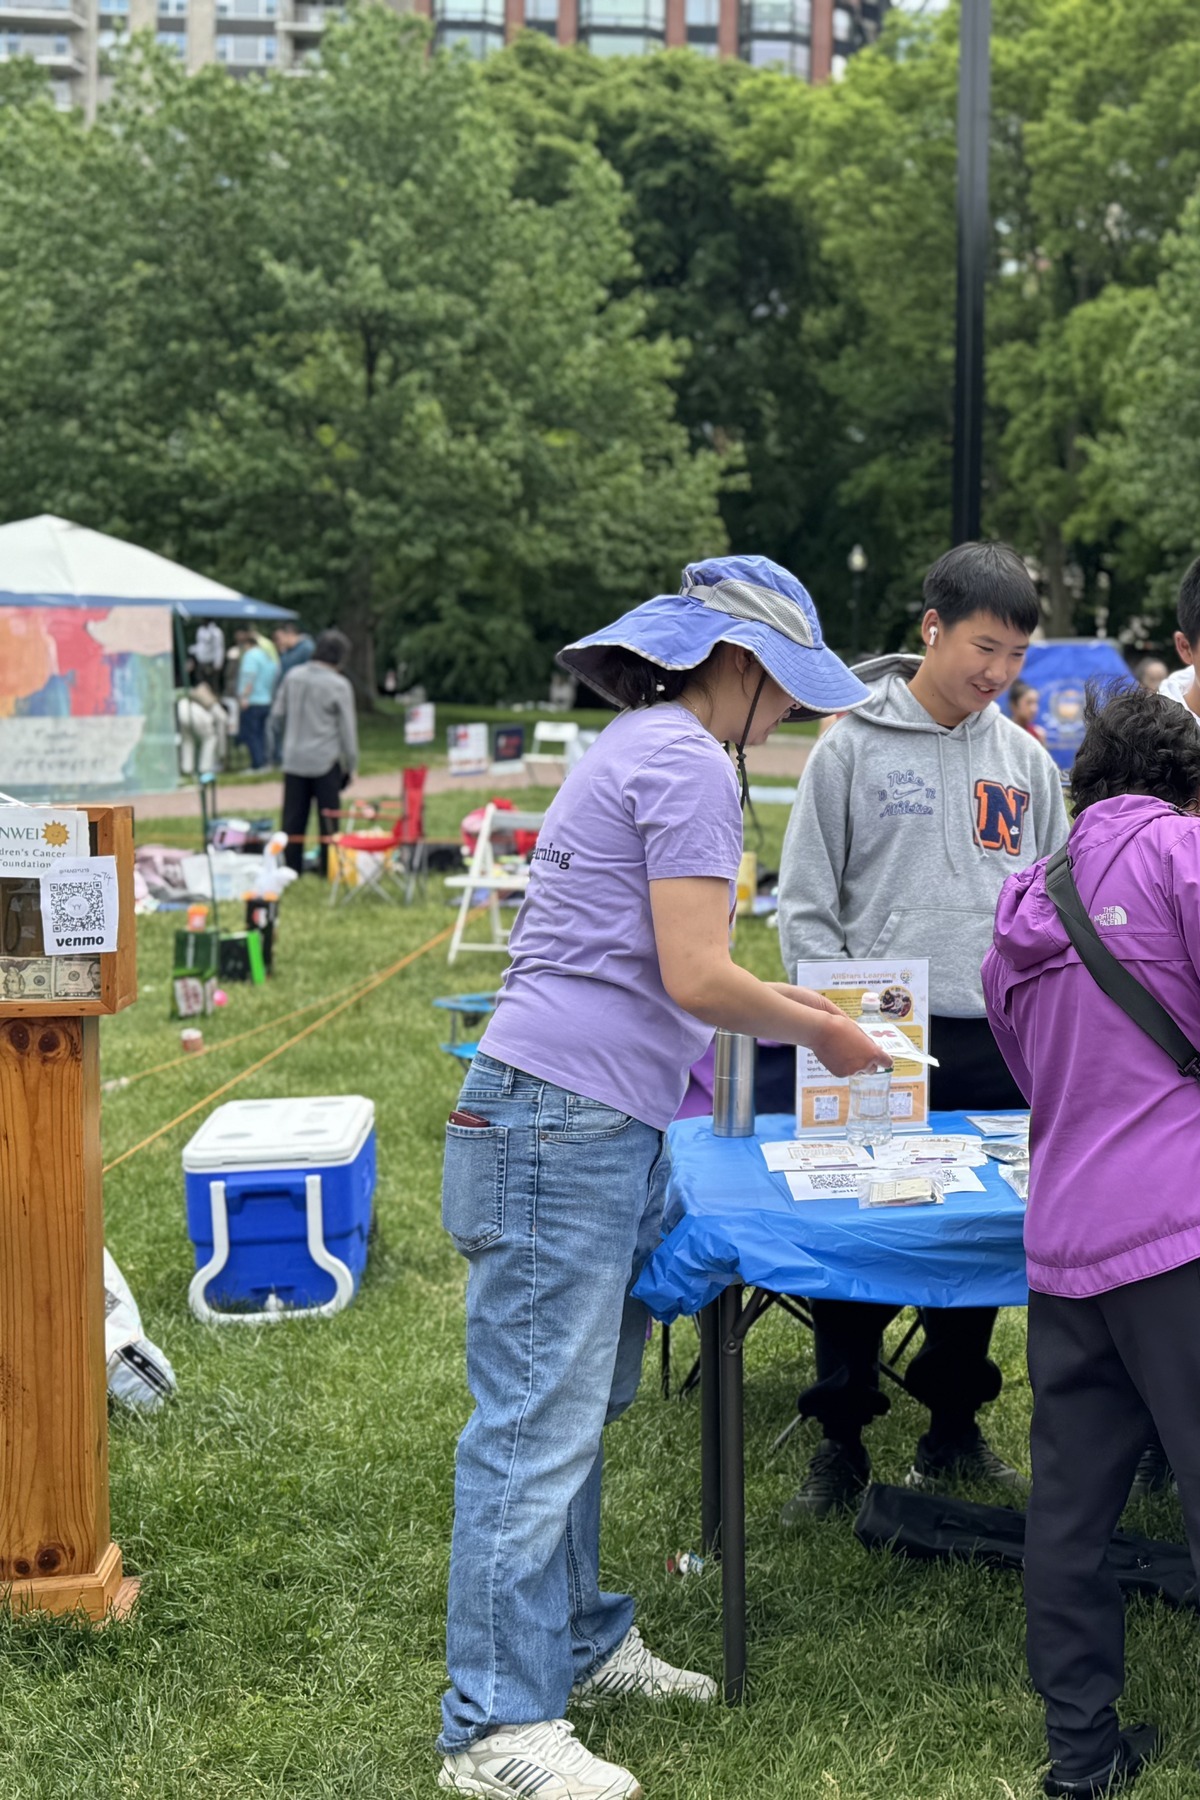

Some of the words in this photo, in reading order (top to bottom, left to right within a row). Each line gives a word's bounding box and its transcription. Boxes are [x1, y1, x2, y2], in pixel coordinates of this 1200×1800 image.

[887, 769, 925, 788] Nike
[973, 779, 1030, 856] N
[32, 849, 66, 858] Cancer
[56, 936, 105, 947] venmo
